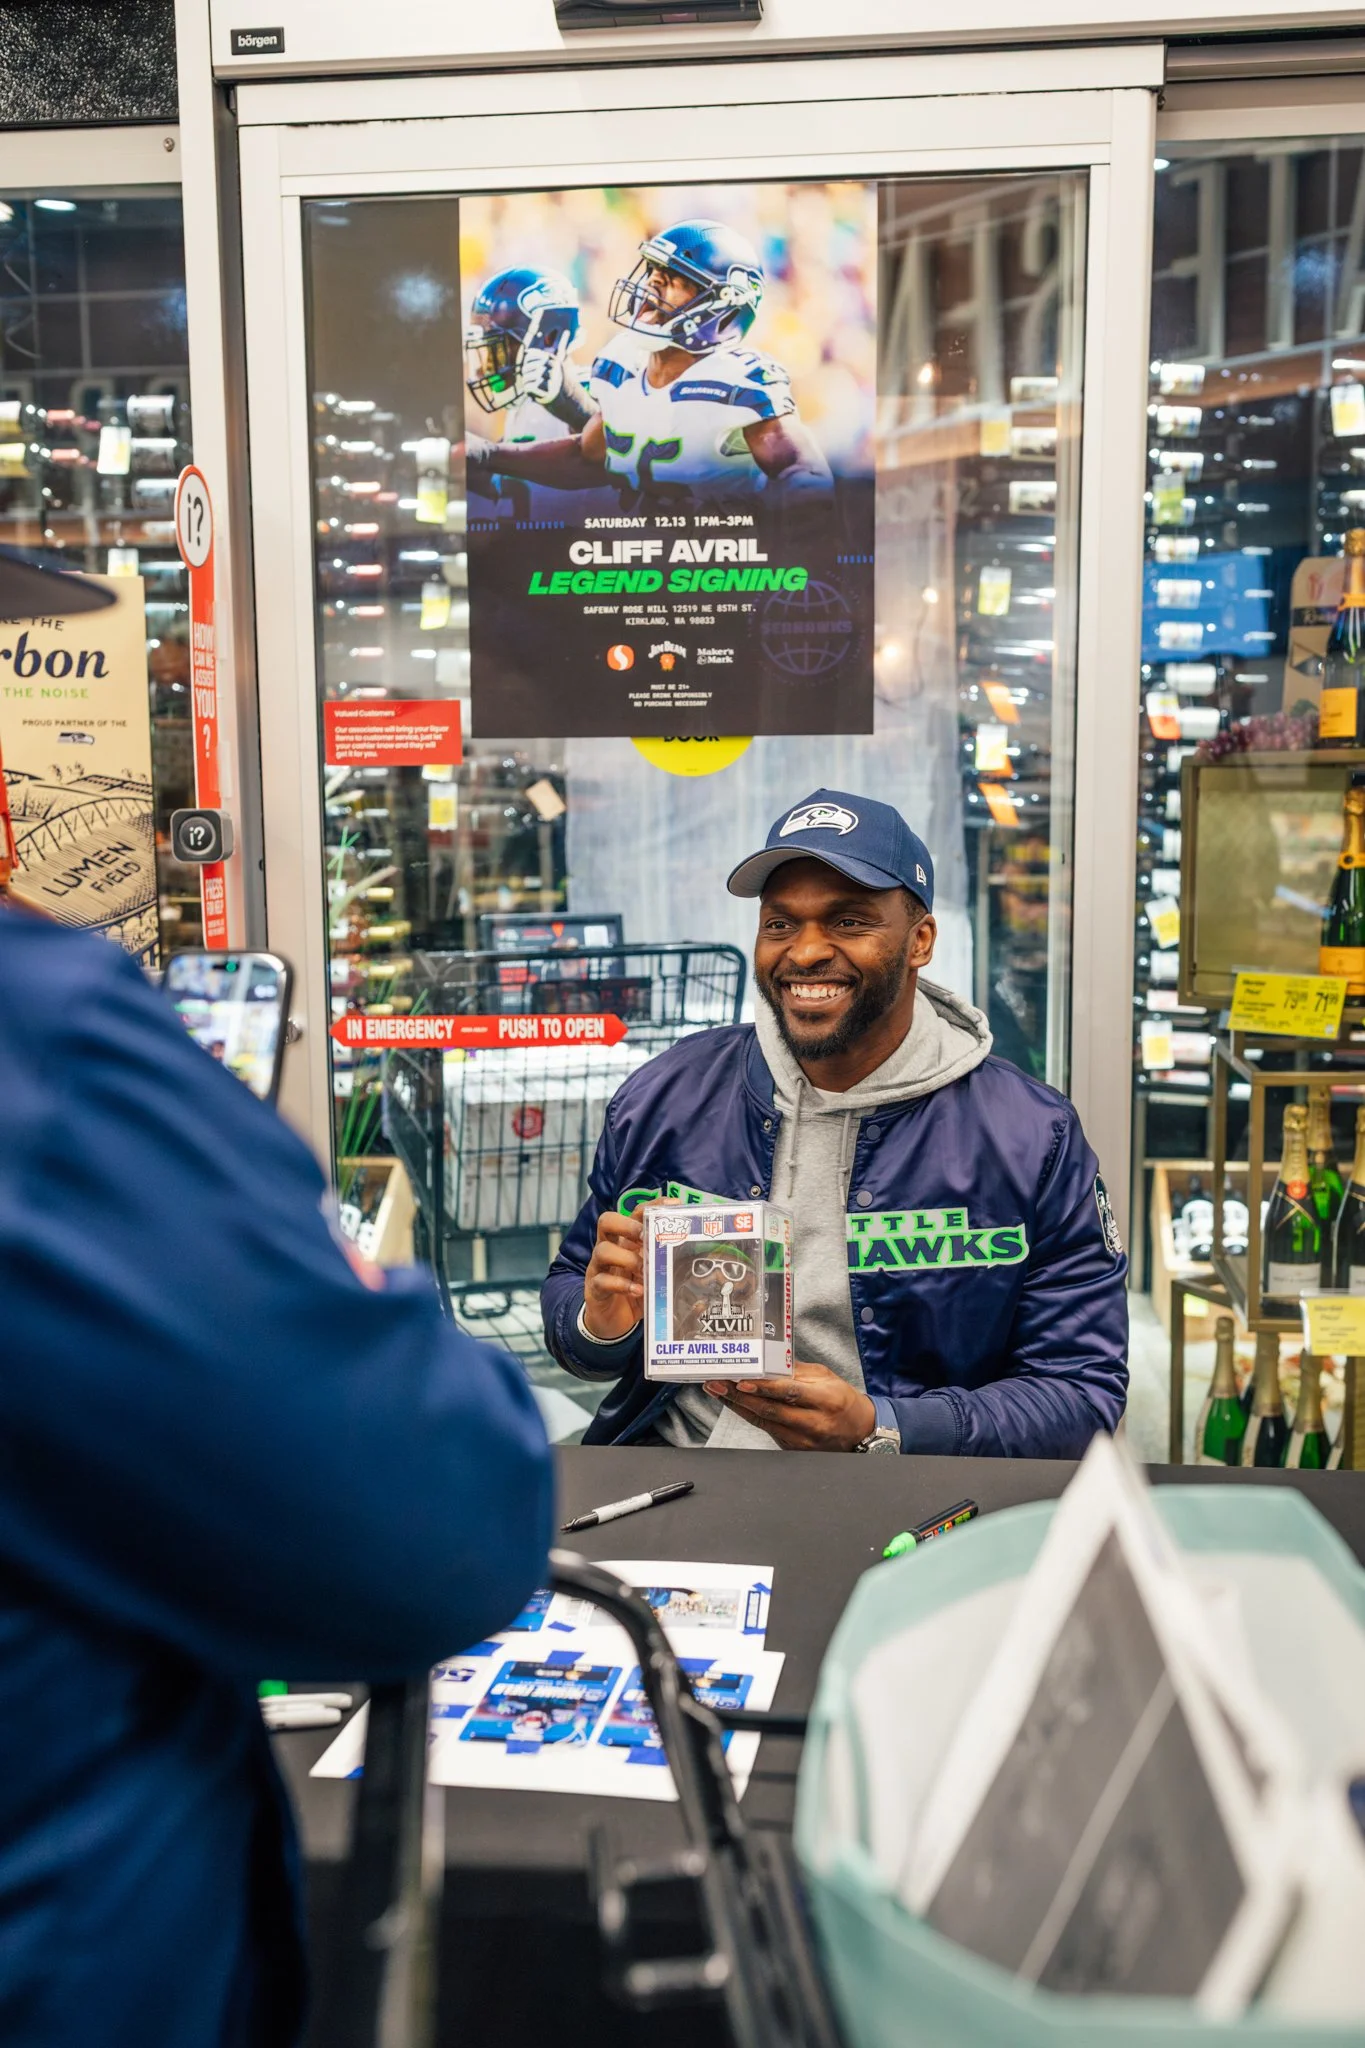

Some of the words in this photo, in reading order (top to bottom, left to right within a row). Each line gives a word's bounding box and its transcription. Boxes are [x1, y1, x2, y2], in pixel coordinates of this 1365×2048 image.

[584, 518, 647, 529] SATURDAY
[654, 517, 686, 528] 12.13
[569, 540, 663, 565] CLIFF
[668, 538, 768, 563] AVRIL
[528, 569, 663, 595] LEGEND
[667, 566, 808, 593] SIGNING
[583, 606, 618, 614] SAFEWAY
[622, 606, 643, 614] ROSE
[647, 605, 668, 613] HILL
[672, 605, 698, 613] 12519
[701, 605, 713, 613] NE
[717, 604, 738, 612] 85TH
[741, 604, 757, 612] ST.
[625, 617, 669, 626] KIRKLAND,
[674, 617, 686, 625] WA
[648, 644, 664, 659] JIM
[663, 640, 687, 658] BEAM
[697, 648, 734, 656] Maker's
[707, 656, 733, 664] Mark
[4, 687, 34, 698] THE
[41, 688, 89, 699] NOISE
[195, 687, 215, 719] YOU
[22, 719, 53, 727] PROUD
[54, 719, 95, 727] PARTNER
[384, 725, 396, 733] will
[395, 725, 414, 734] bring
[203, 723, 211, 759] ?
[419, 733, 433, 742] just
[335, 743, 351, 751] your
[409, 741, 424, 750] they
[336, 751, 348, 760] get
[41, 841, 137, 897] LUMEN
[90, 861, 141, 893] FIELD
[346, 1019, 362, 1040] IN
[365, 1019, 455, 1040] EMERGENCY
[498, 1019, 538, 1039] PUSH
[541, 1018, 561, 1039] TO
[565, 1017, 605, 1038] OPEN
[656, 1216, 692, 1234] POP!
[704, 1221, 722, 1234] NFL
[735, 1216, 752, 1229] SE
[851, 1213, 962, 1232] TTLE
[701, 1319, 753, 1333] XLVIII
[656, 1343, 685, 1355] CLIFF
[687, 1343, 719, 1354] AVRIL
[721, 1343, 750, 1354] SB48
